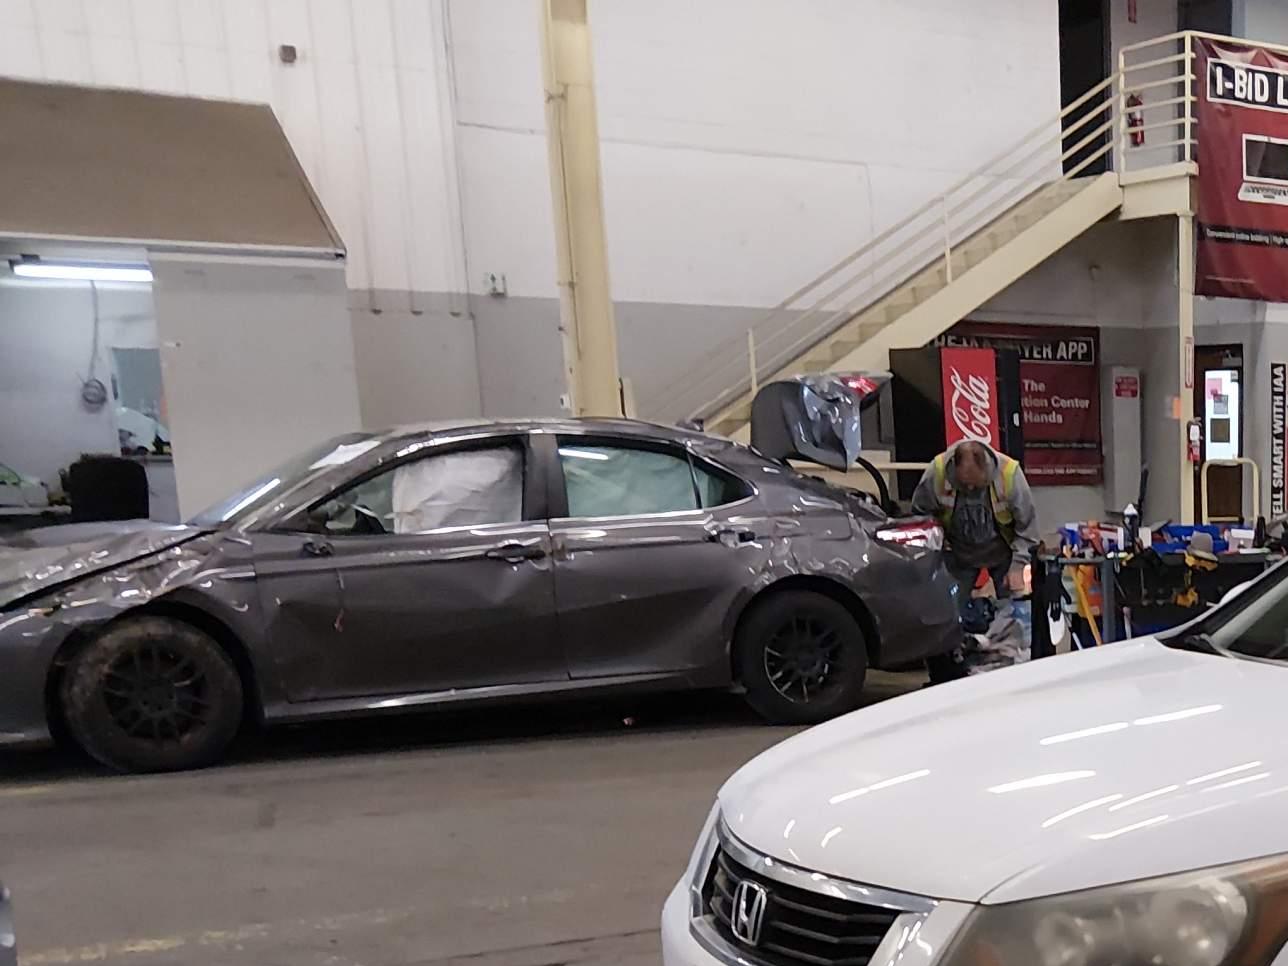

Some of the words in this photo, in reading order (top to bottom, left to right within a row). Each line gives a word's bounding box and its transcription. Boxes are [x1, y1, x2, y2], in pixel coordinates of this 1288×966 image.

[1215, 66, 1270, 104] I-BID
[1017, 343, 1052, 360] YER
[1056, 340, 1088, 360] APP
[1023, 379, 1045, 392] The
[1272, 366, 1285, 392] IAA
[1051, 396, 1090, 409] Center
[1023, 410, 1063, 424] Hands
[1272, 395, 1284, 435] WITH
[1272, 438, 1284, 487] SMART
